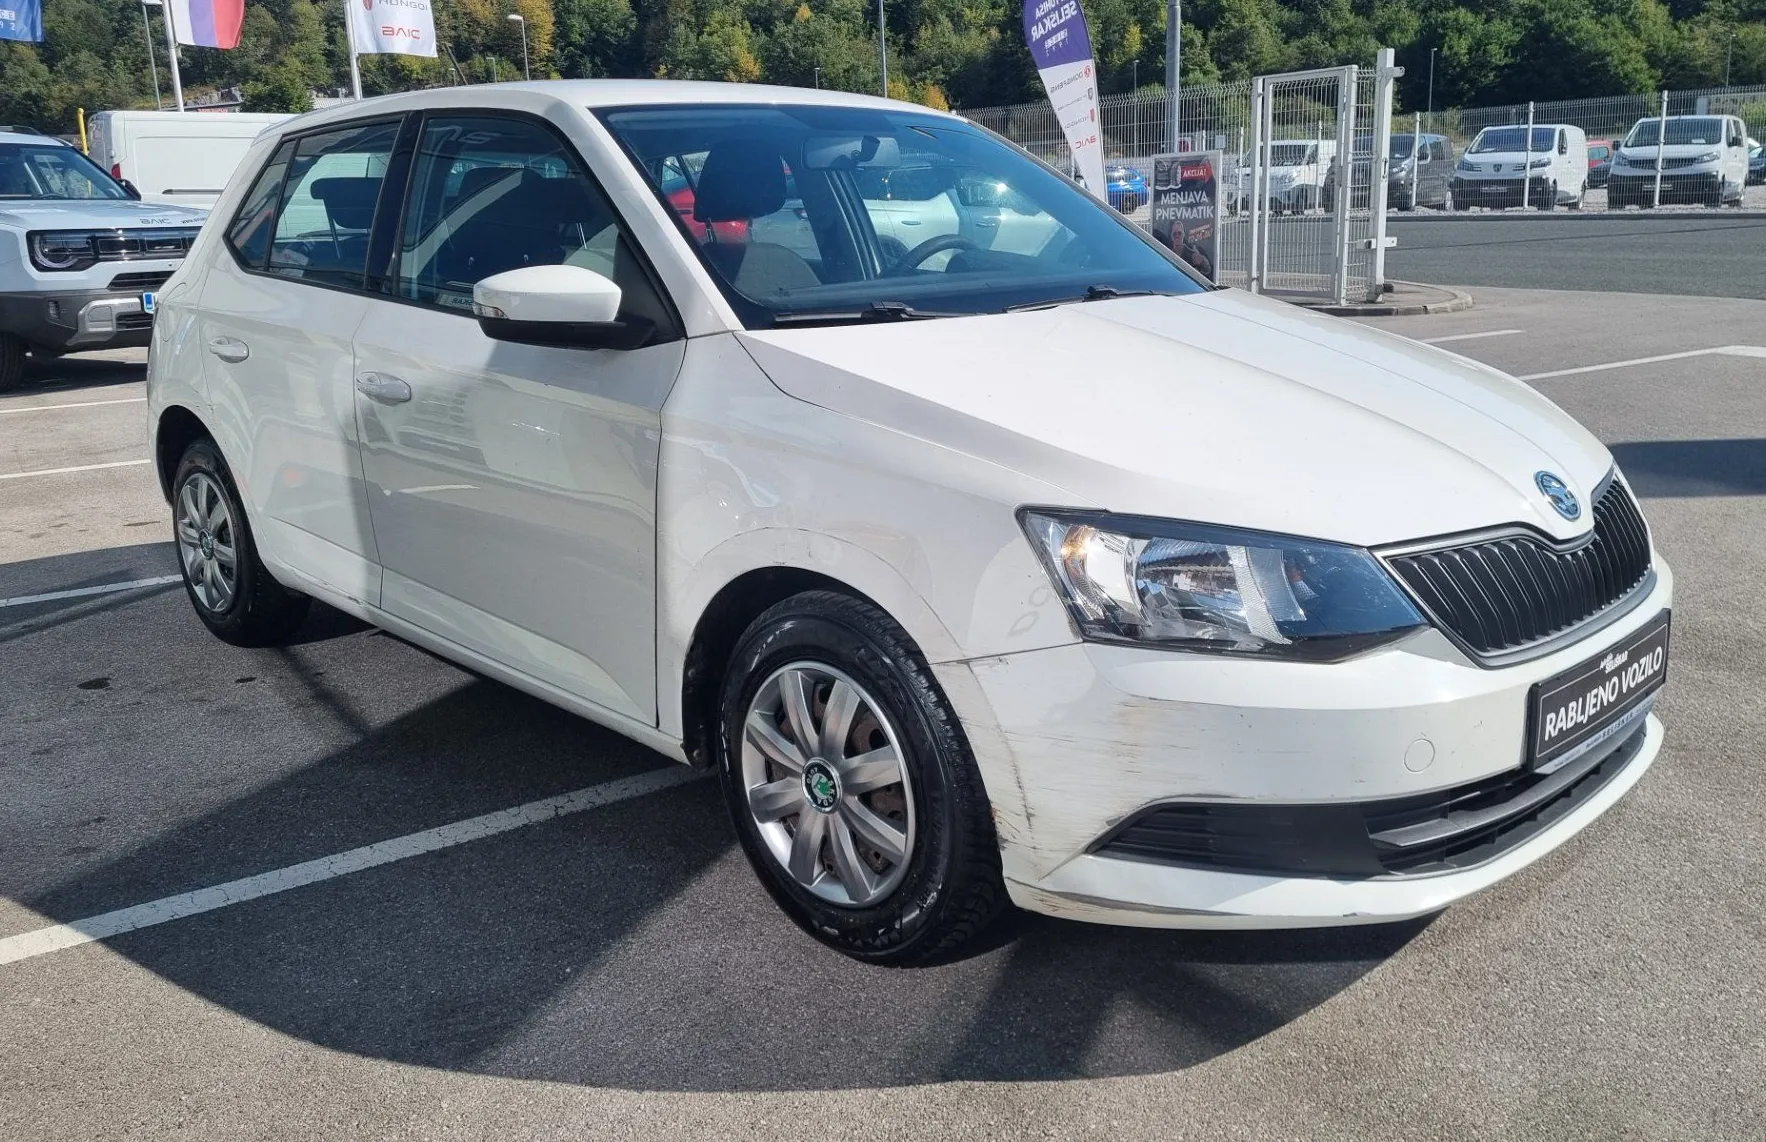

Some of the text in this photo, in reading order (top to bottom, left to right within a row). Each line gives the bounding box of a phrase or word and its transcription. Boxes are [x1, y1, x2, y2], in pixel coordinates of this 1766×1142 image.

[382, 26, 420, 40] BAIC
[1160, 190, 1209, 205] MENJAVA
[1155, 205, 1214, 220] PNEVMATIK
[1545, 646, 1663, 741] RABLJENO VOZILO
